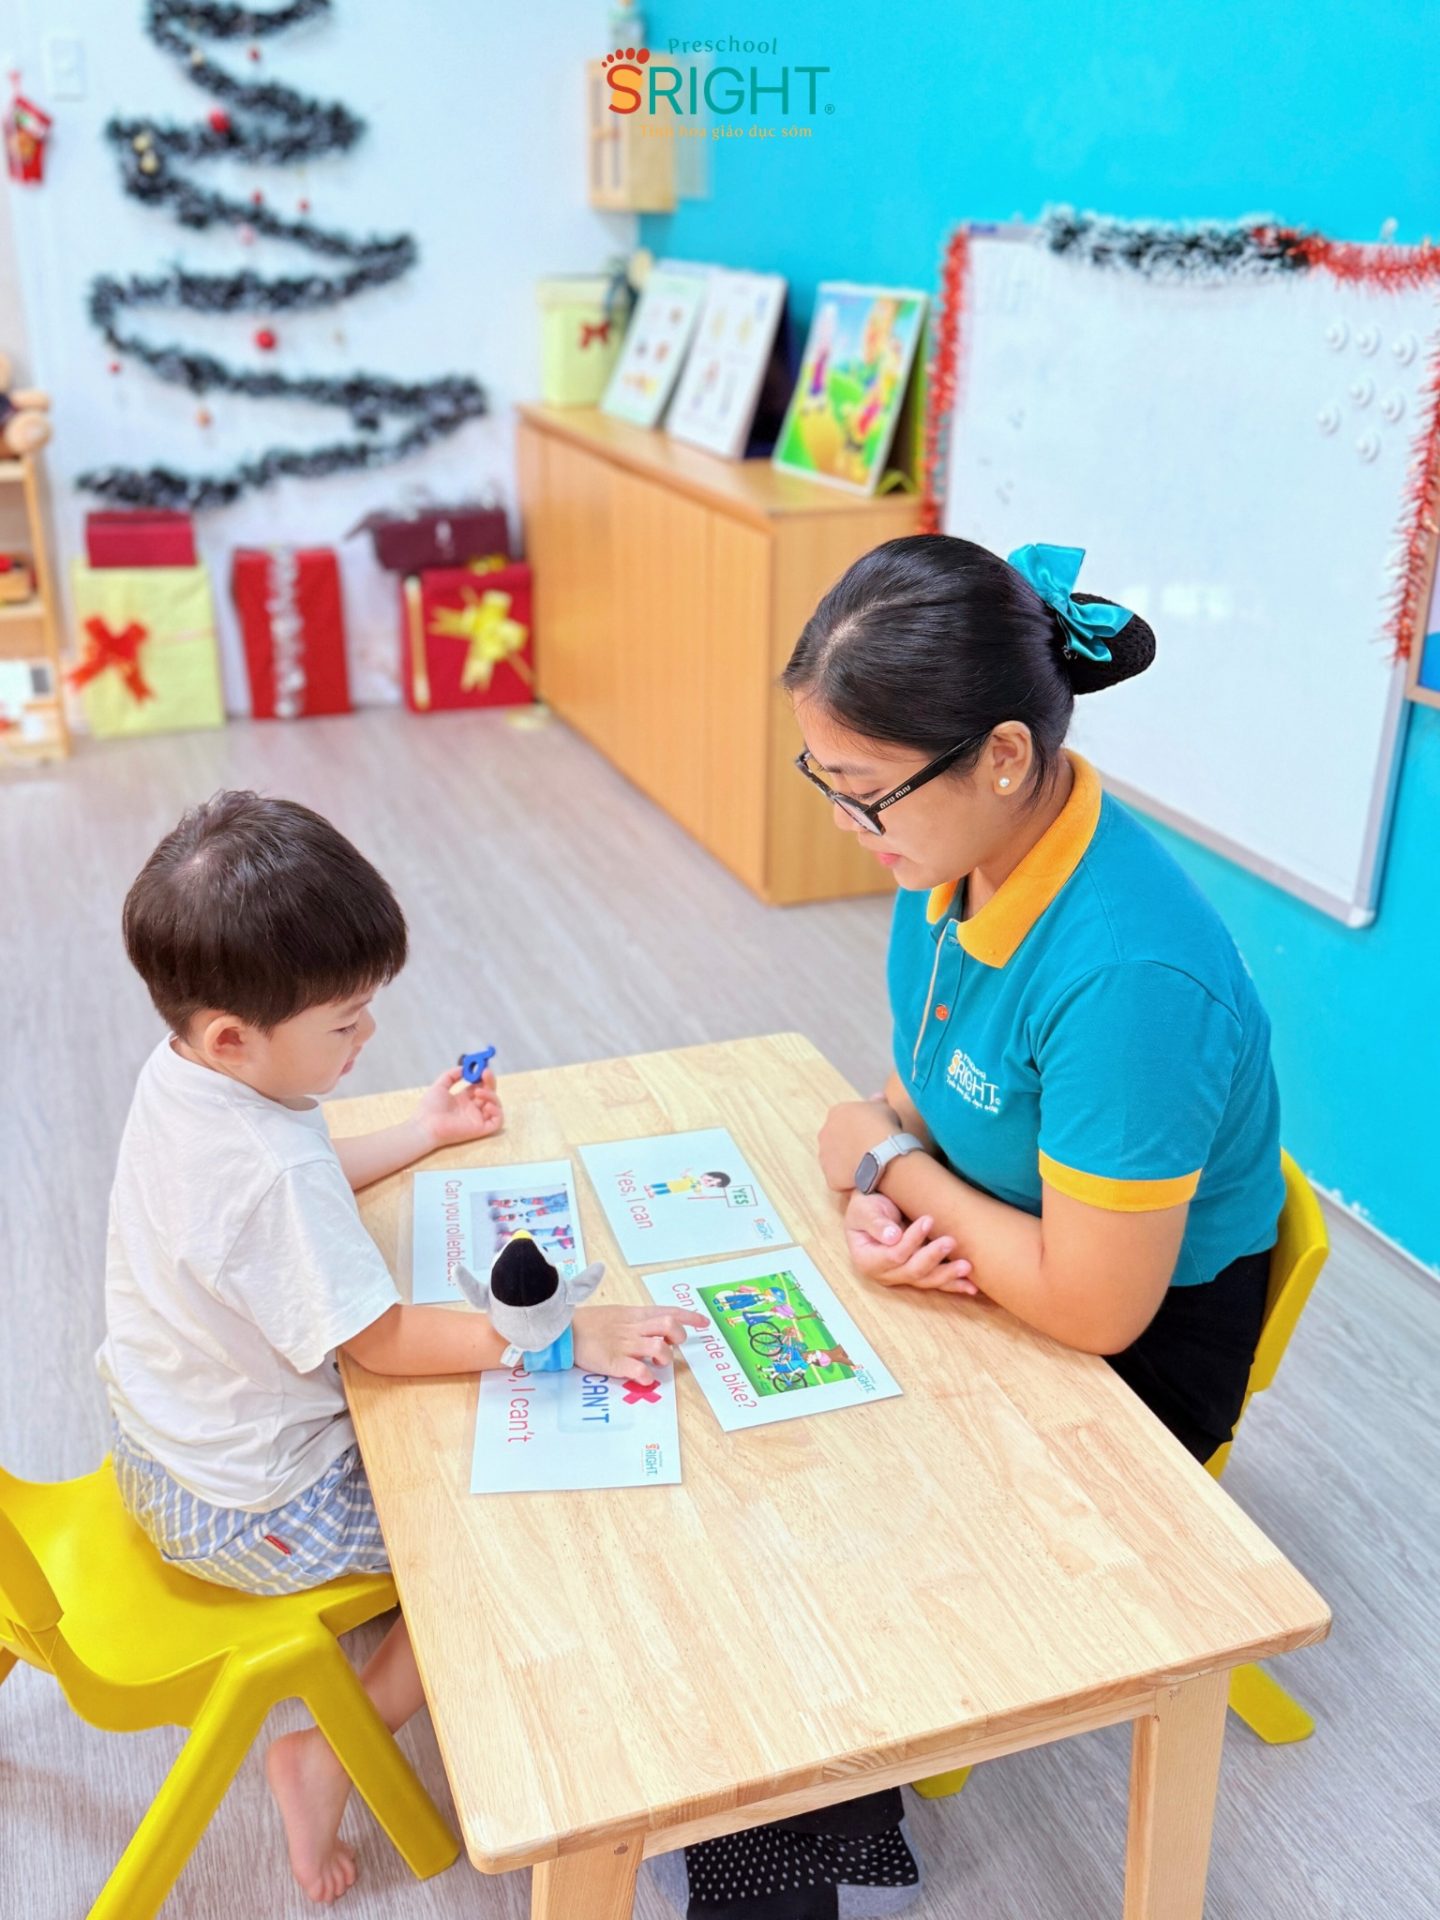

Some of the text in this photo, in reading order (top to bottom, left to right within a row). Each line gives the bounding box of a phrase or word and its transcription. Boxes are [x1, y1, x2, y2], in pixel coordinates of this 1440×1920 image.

[445, 1179, 462, 1200] Can
[614, 1169, 637, 1197] Yes,
[630, 1205, 653, 1229] can
[732, 1187, 750, 1205] YES
[441, 1201, 460, 1221] you
[672, 1283, 694, 1306] Can
[699, 1334, 726, 1360] ride
[715, 1362, 730, 1372] a
[582, 1373, 609, 1423] CAN'T
[721, 1373, 757, 1408] bike?
[508, 1398, 535, 1442] can't
